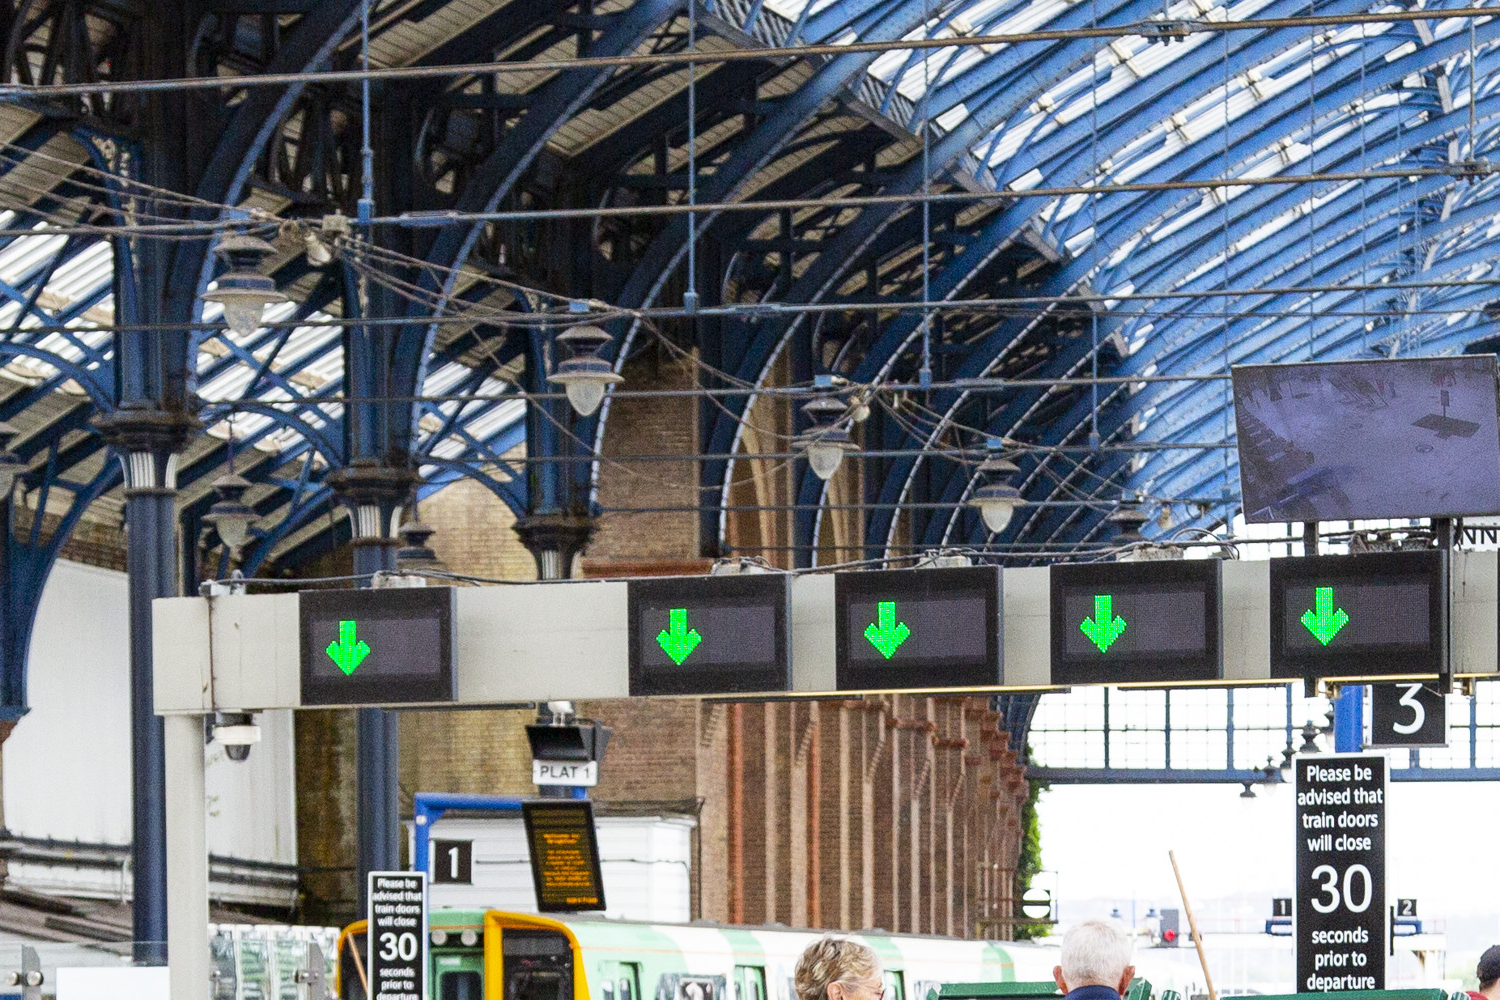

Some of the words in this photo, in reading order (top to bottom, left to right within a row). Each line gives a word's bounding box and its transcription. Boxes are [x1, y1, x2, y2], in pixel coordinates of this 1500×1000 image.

[1393, 683, 1426, 735] 3
[540, 766, 578, 779] PLAT
[585, 767, 590, 779] 1
[1307, 765, 1351, 782] Please
[1354, 763, 1372, 781] be
[1298, 788, 1350, 806] advised
[1353, 786, 1384, 805] that
[1302, 812, 1335, 829] train
[1338, 811, 1378, 828] doors
[1307, 834, 1332, 851] will
[1335, 833, 1371, 851] close
[448, 847, 458, 879] 1
[377, 877, 403, 890] Please
[405, 878, 418, 889] be
[1311, 864, 1373, 913] 30
[372, 891, 403, 902] advised
[405, 890, 421, 902] that
[375, 904, 394, 915] train
[395, 903, 419, 915] doors
[1280, 900, 1286, 915] 1
[1402, 900, 1412, 915] 2
[377, 916, 392, 927] will
[394, 916, 417, 927] close
[1312, 925, 1368, 944] seconds
[379, 932, 418, 961] 30
[1314, 947, 1348, 969] prior
[1351, 949, 1367, 967] to
[380, 966, 415, 978] seconds
[381, 979, 402, 991] prior
[403, 980, 415, 990] to
[1306, 971, 1375, 992] departure
